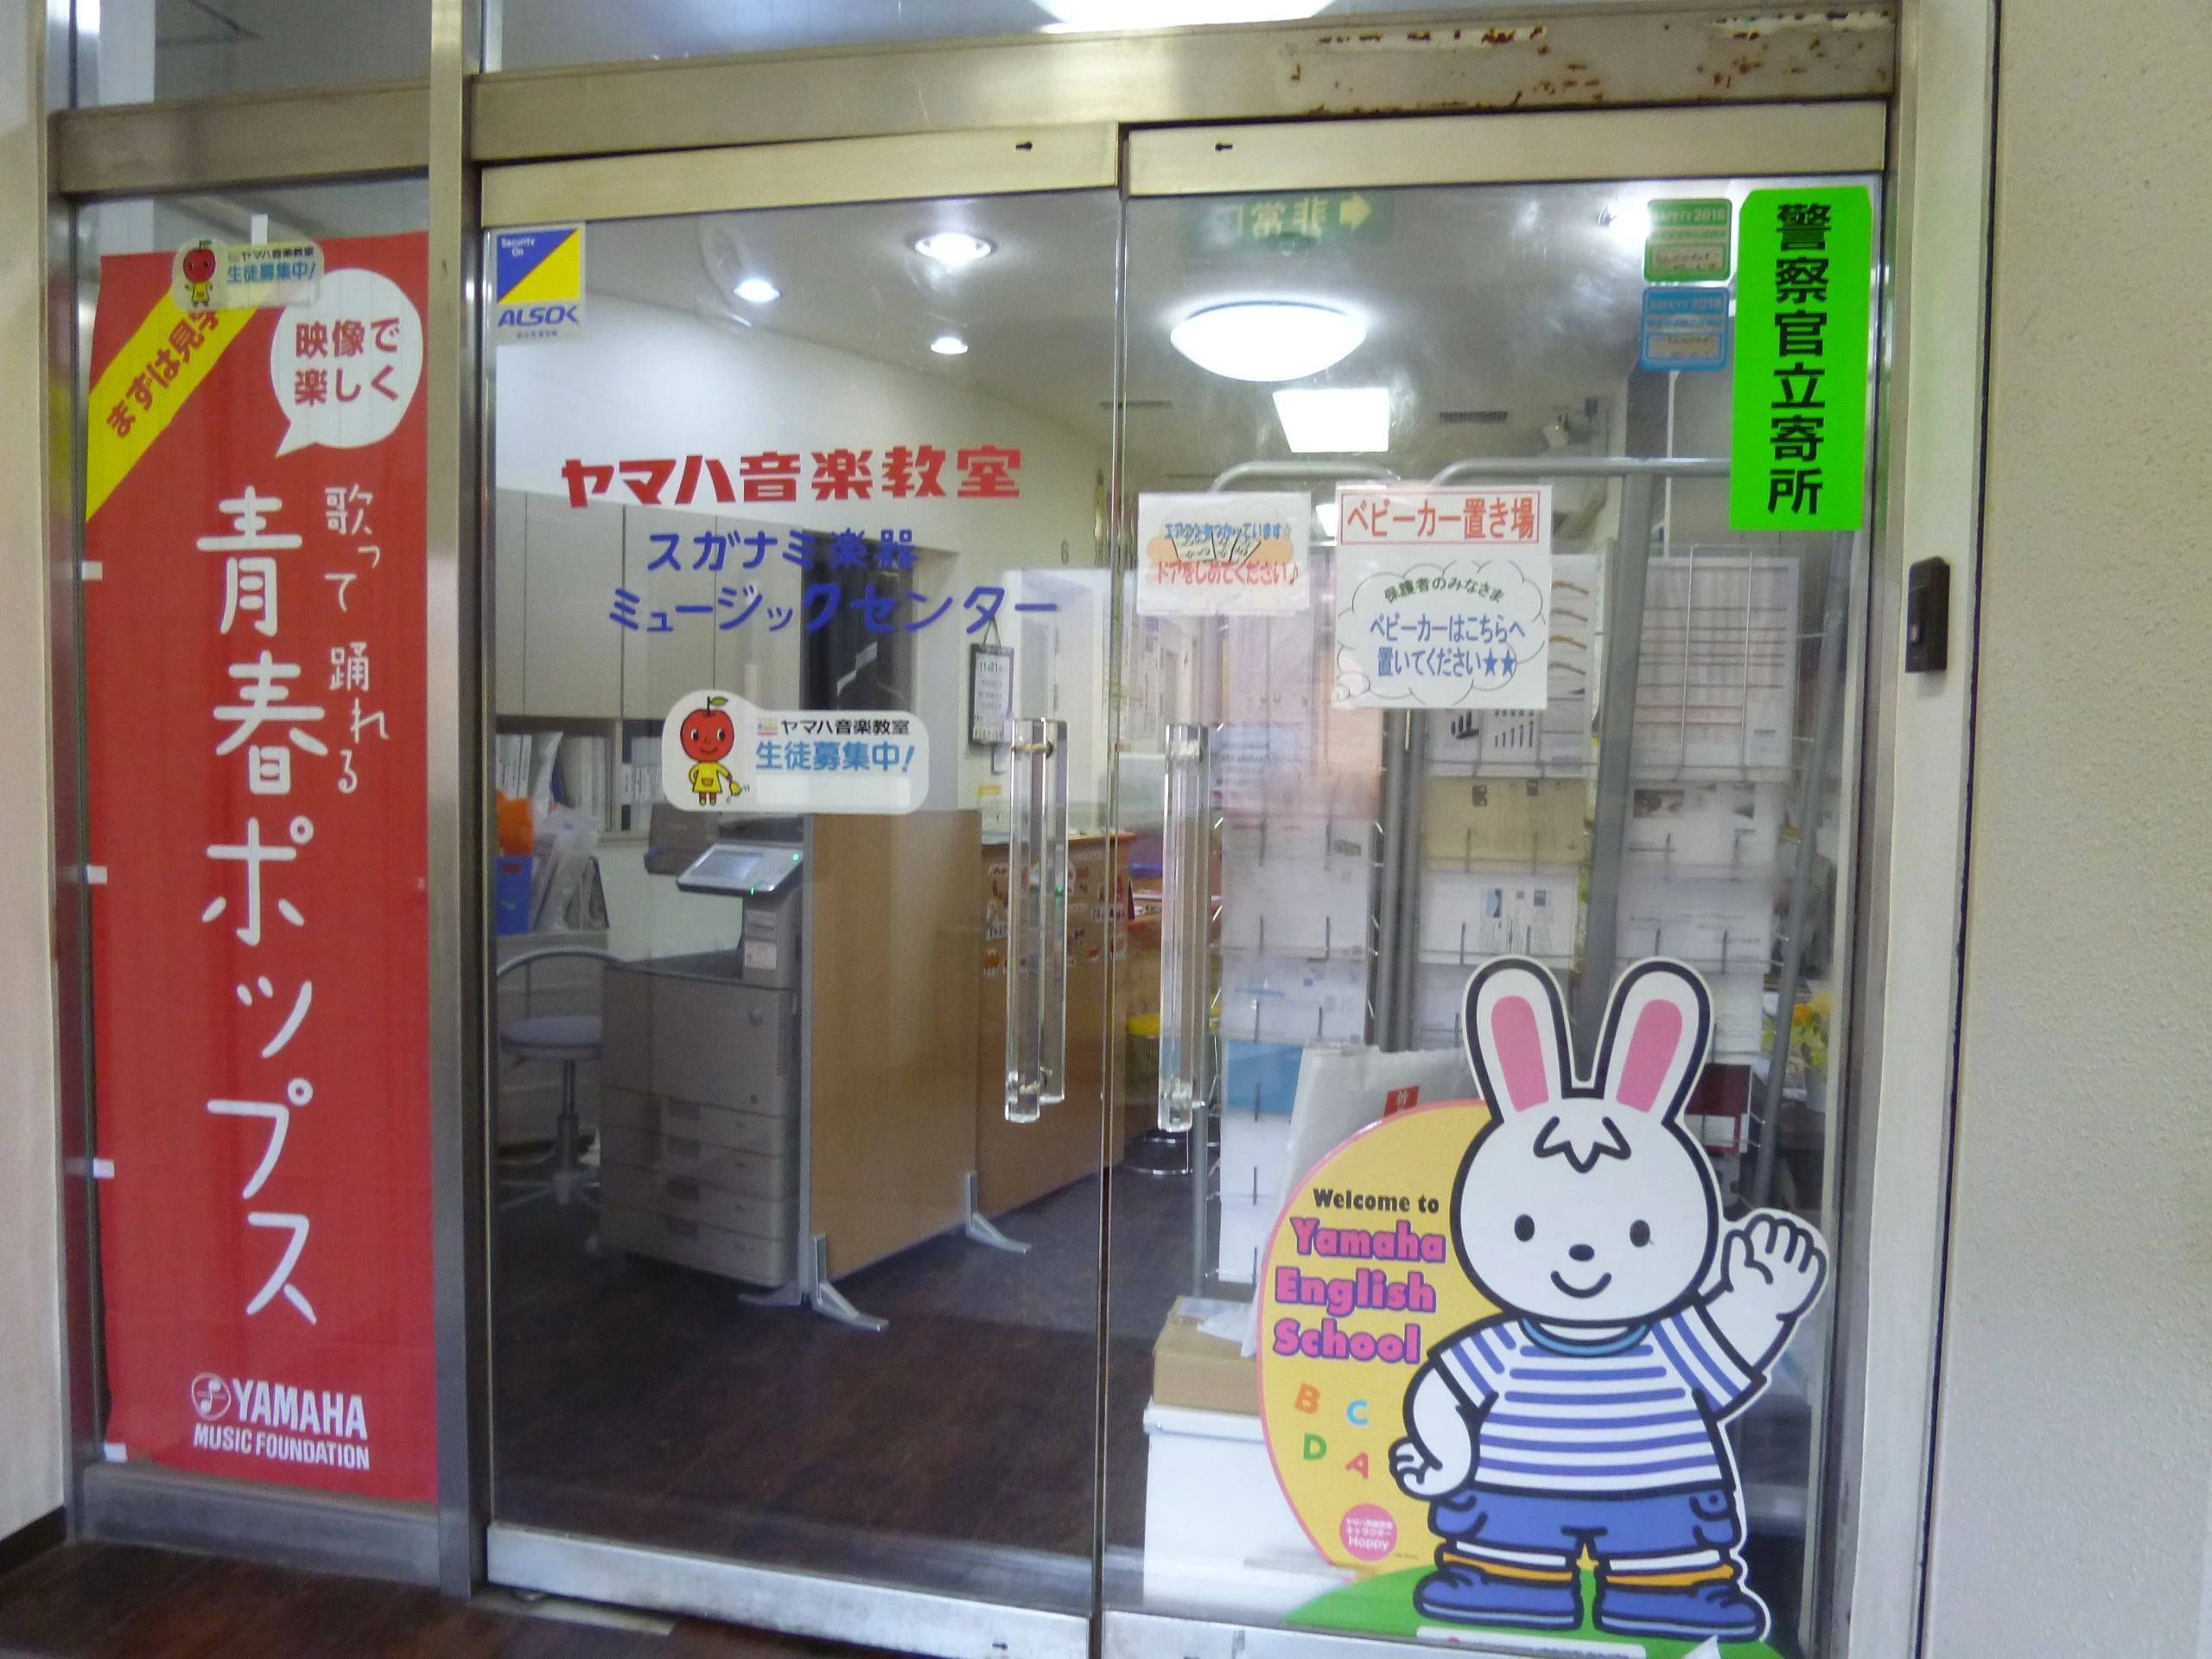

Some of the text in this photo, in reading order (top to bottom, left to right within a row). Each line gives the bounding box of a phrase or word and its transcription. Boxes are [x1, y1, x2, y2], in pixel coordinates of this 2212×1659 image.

[501, 237, 536, 257] Security On
[295, 318, 400, 358] 映像で
[497, 305, 580, 328] ALSOK
[1767, 203, 1832, 515] 警察官立寄所
[294, 365, 400, 406] 楽しく
[562, 445, 1020, 509] ヤマハ音楽教室
[1347, 497, 1535, 540] ベビーカー置き場
[648, 527, 919, 572] スガナミ楽器
[608, 584, 1058, 633] ミュージックセンター
[1384, 577, 1505, 603] 保護者のみなさま
[324, 484, 390, 794] 歌って 踊れる
[781, 719, 910, 735] ヤマハ音楽教室
[196, 485, 328, 1325] 青春ポップス
[1313, 1188, 1440, 1213] Welcome to
[1289, 1217, 1446, 1263] Yamaha
[1274, 1265, 1437, 1318] English
[1272, 1318, 1421, 1364] School
[232, 1377, 368, 1440] YAMAHA
[1294, 1382, 1370, 1427] B C
[194, 1422, 371, 1471] MUSIC FOUNDATION
[1303, 1432, 1369, 1480] D A
[1348, 1535, 1389, 1552] Hoppy
